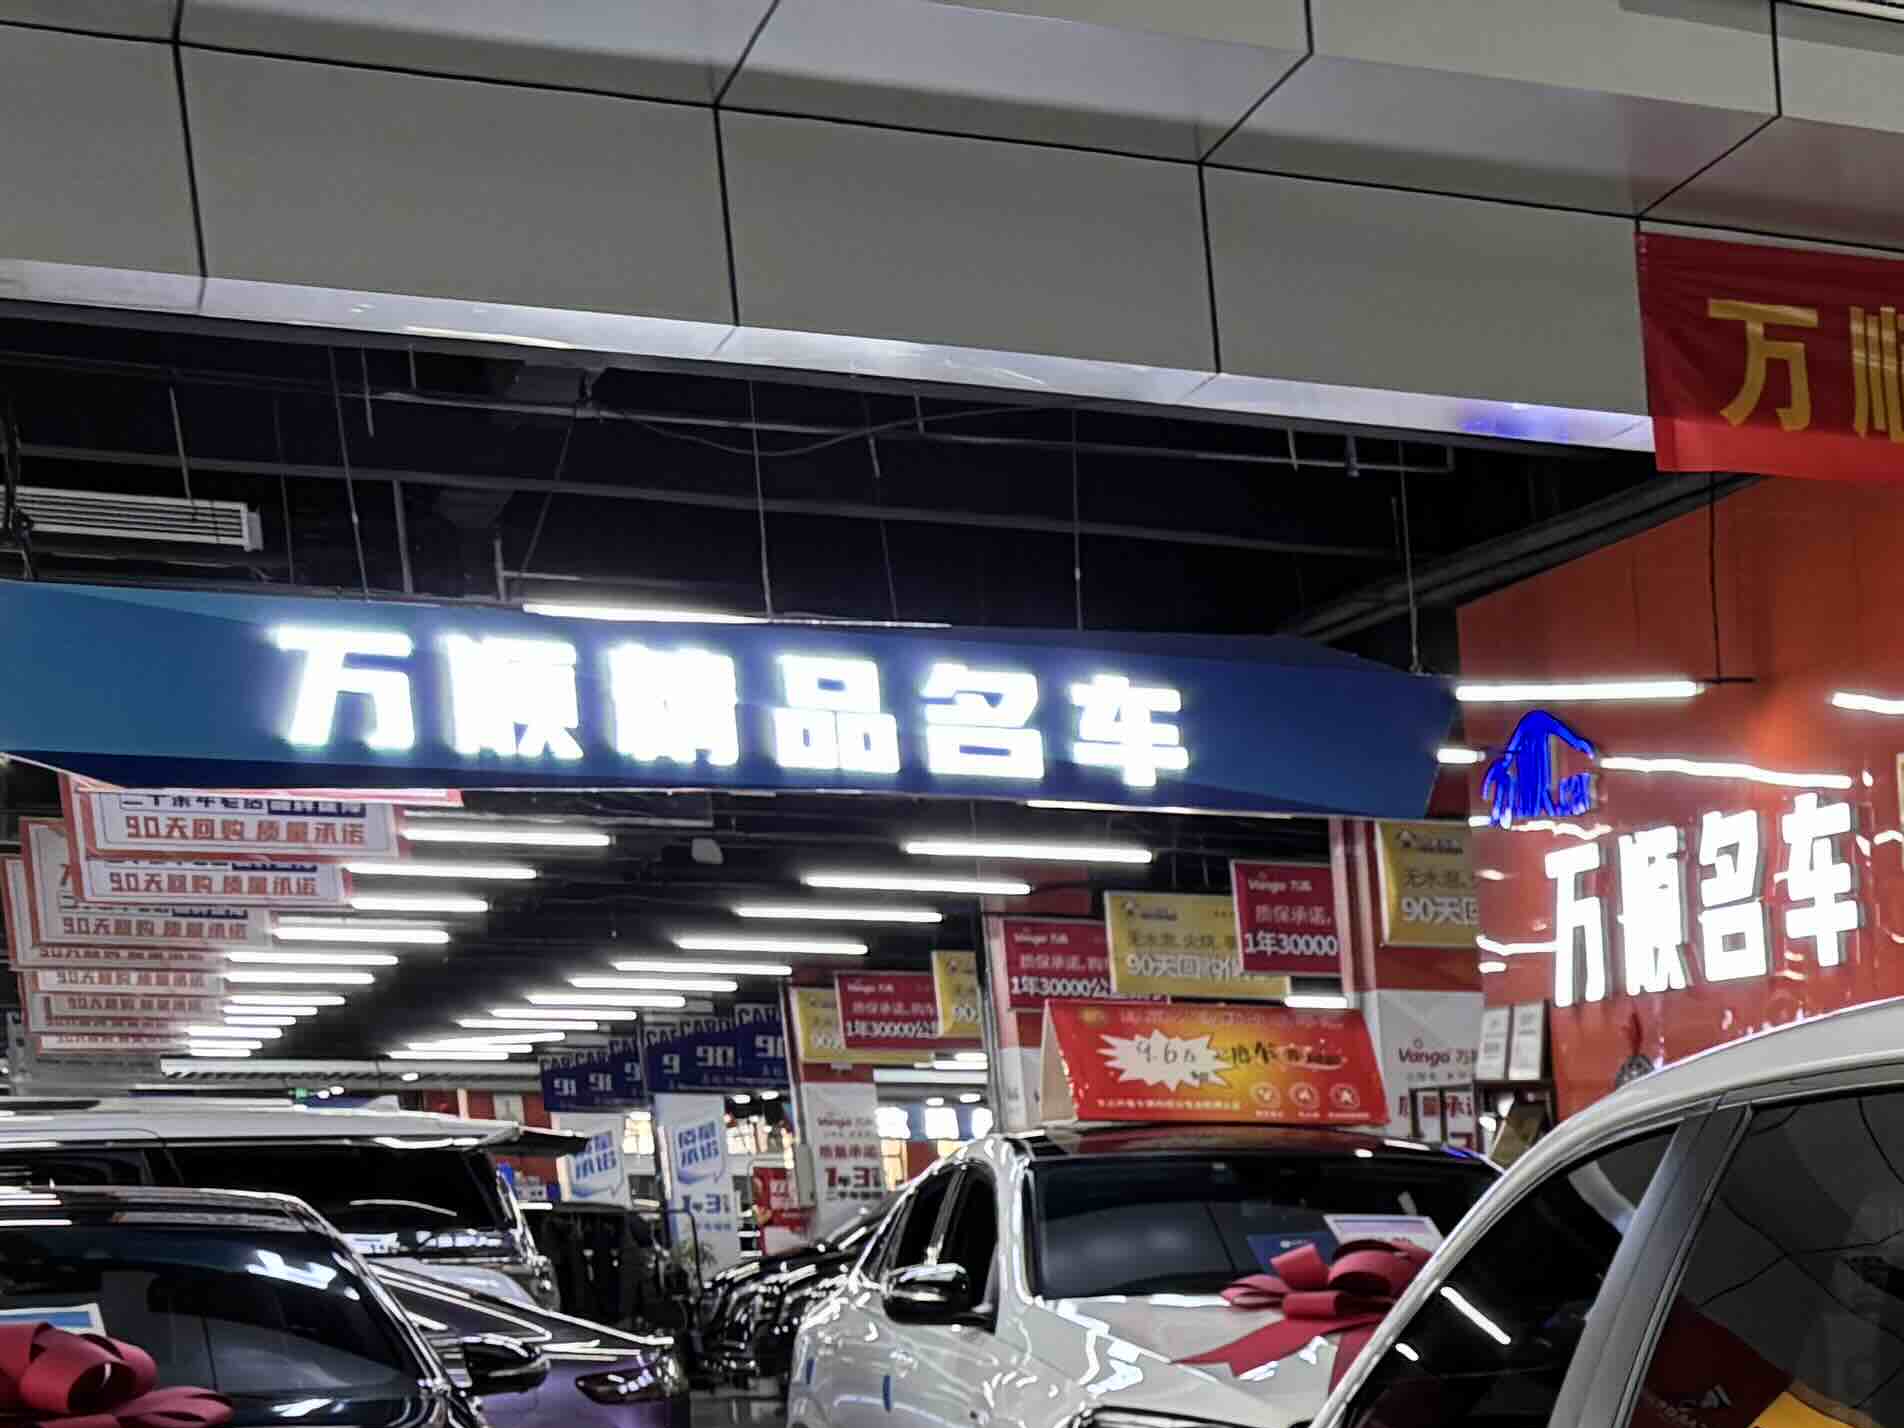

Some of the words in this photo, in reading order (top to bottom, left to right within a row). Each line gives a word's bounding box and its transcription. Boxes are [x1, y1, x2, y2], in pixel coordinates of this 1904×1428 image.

[270, 620, 1190, 790] 万顺精品名车
[126, 815, 246, 843] 90天回购
[1545, 792, 1862, 1008] 万顺名车
[1398, 1047, 1451, 1067] Vango
